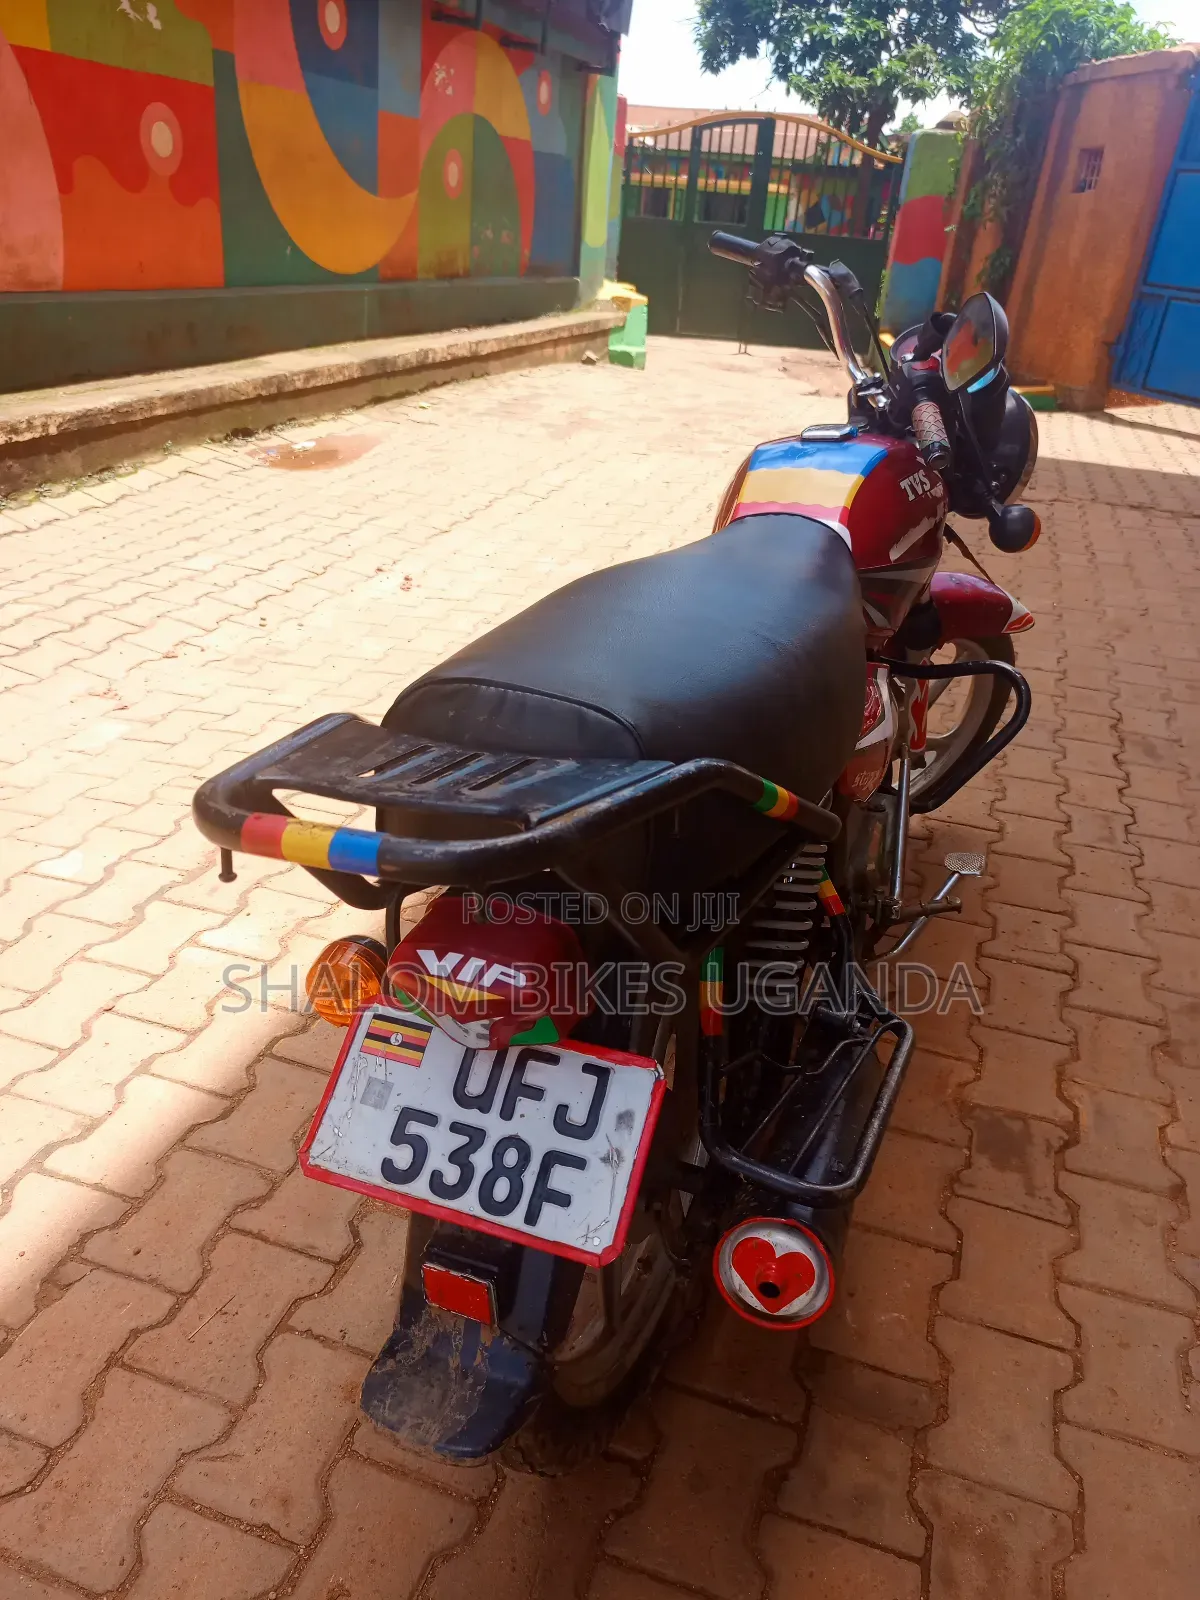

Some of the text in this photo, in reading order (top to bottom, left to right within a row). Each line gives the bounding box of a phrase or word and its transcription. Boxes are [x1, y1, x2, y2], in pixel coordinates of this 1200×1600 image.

[900, 470, 930, 501] TVS
[416, 949, 527, 989] VIP
[452, 1047, 612, 1141] UFJ
[380, 1106, 588, 1227] 538F
